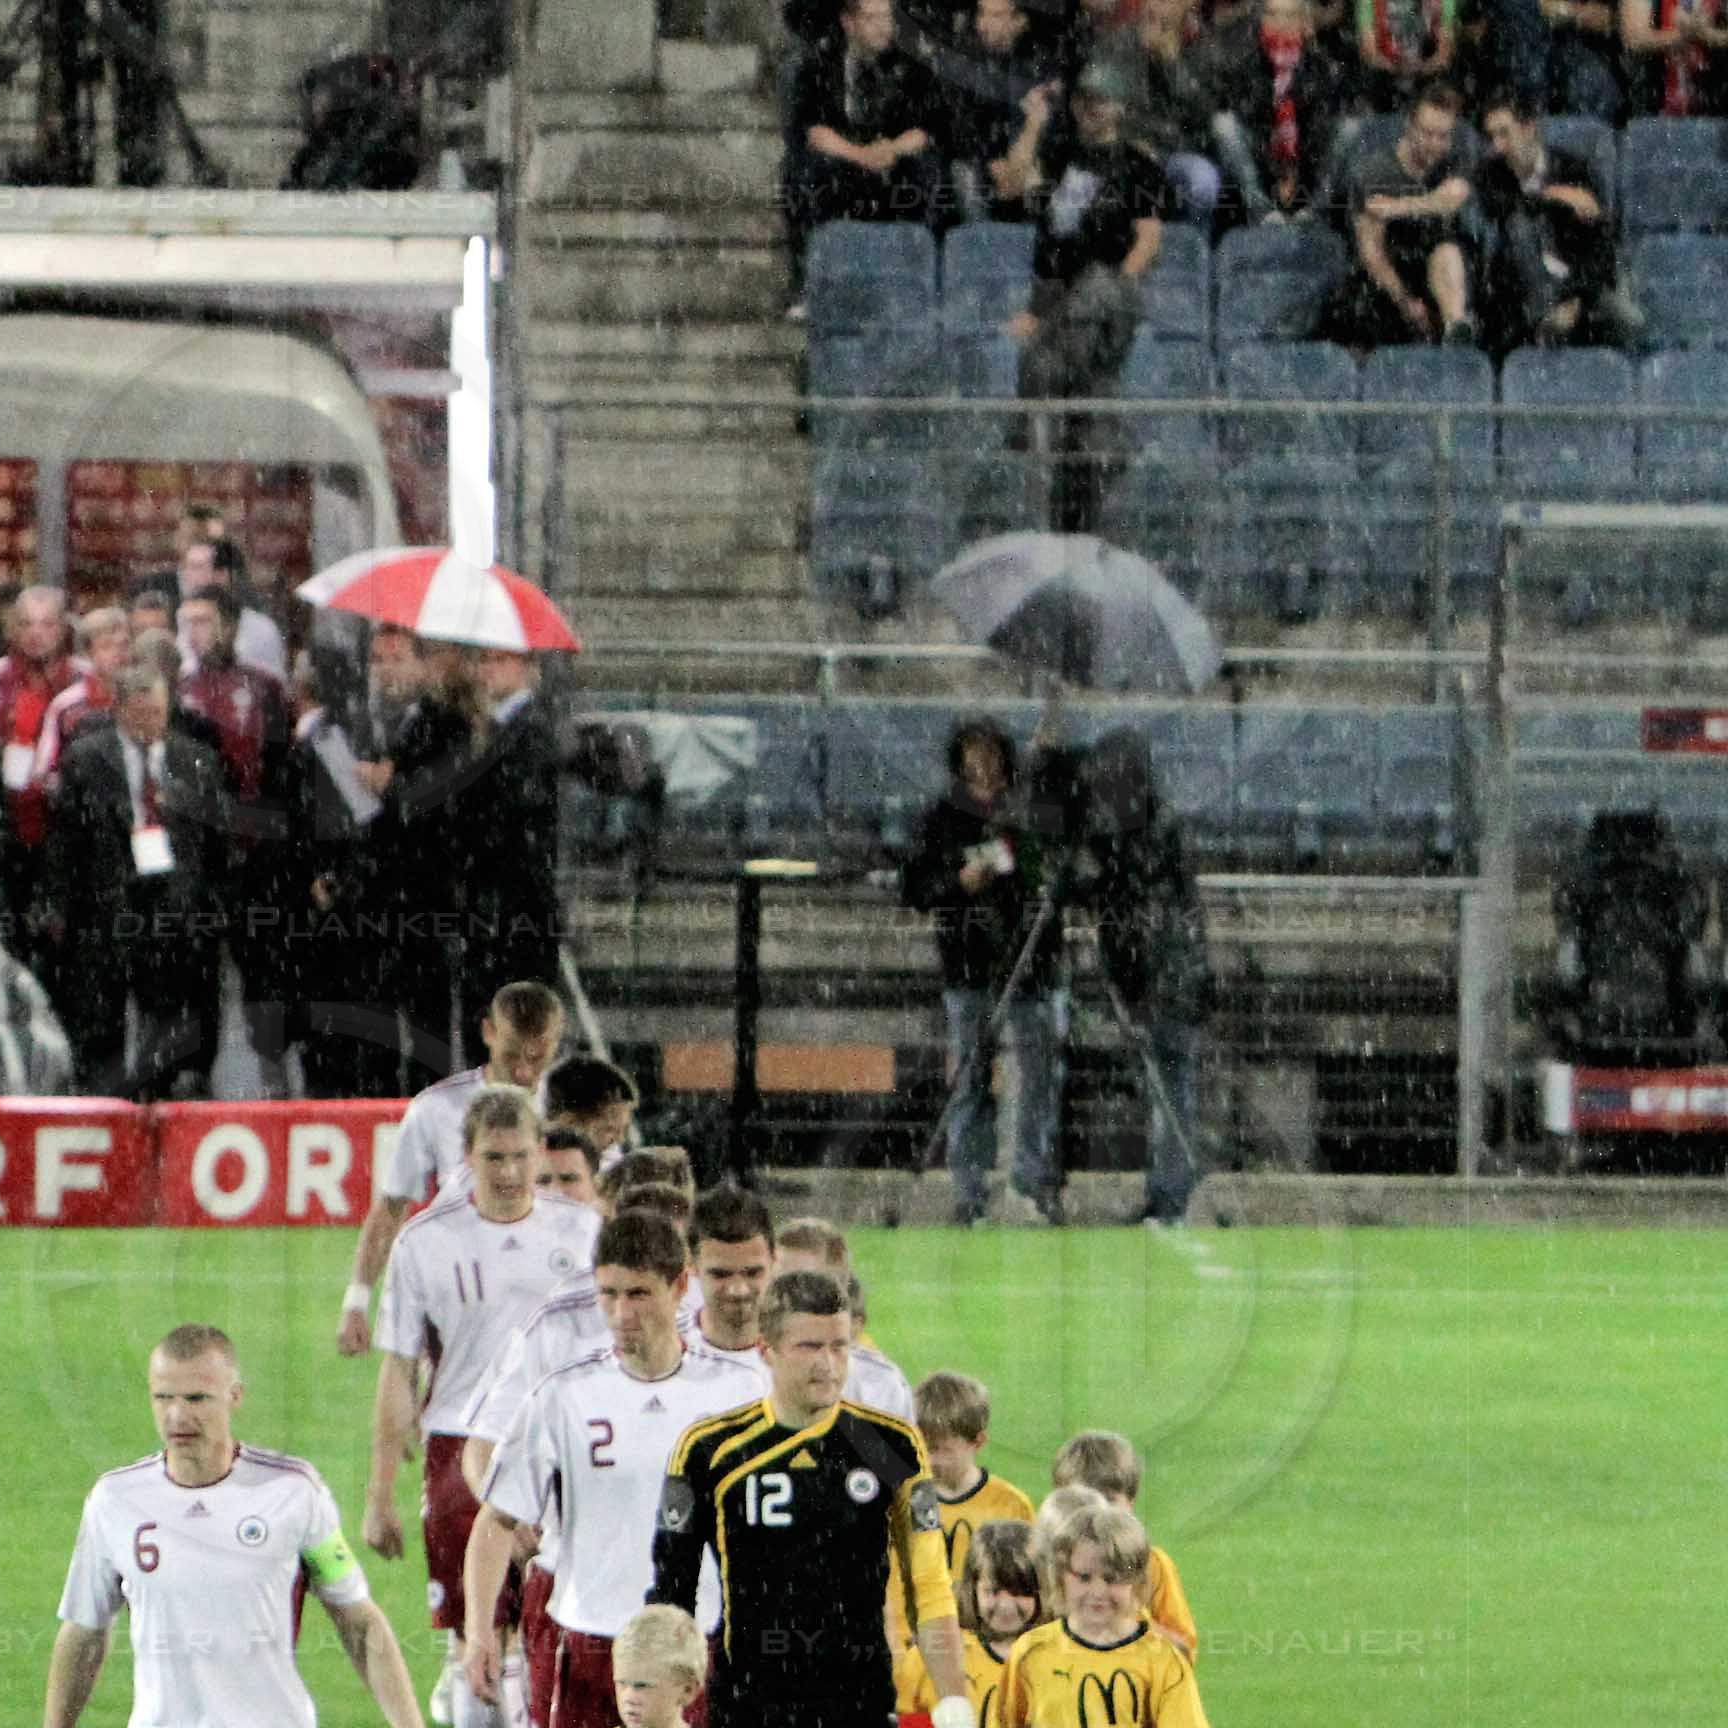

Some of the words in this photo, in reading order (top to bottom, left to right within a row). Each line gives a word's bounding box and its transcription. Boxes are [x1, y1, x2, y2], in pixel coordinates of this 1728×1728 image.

[586, 1419, 616, 1469] 2
[745, 1473, 793, 1527] 12
[132, 1521, 161, 1575] 6
